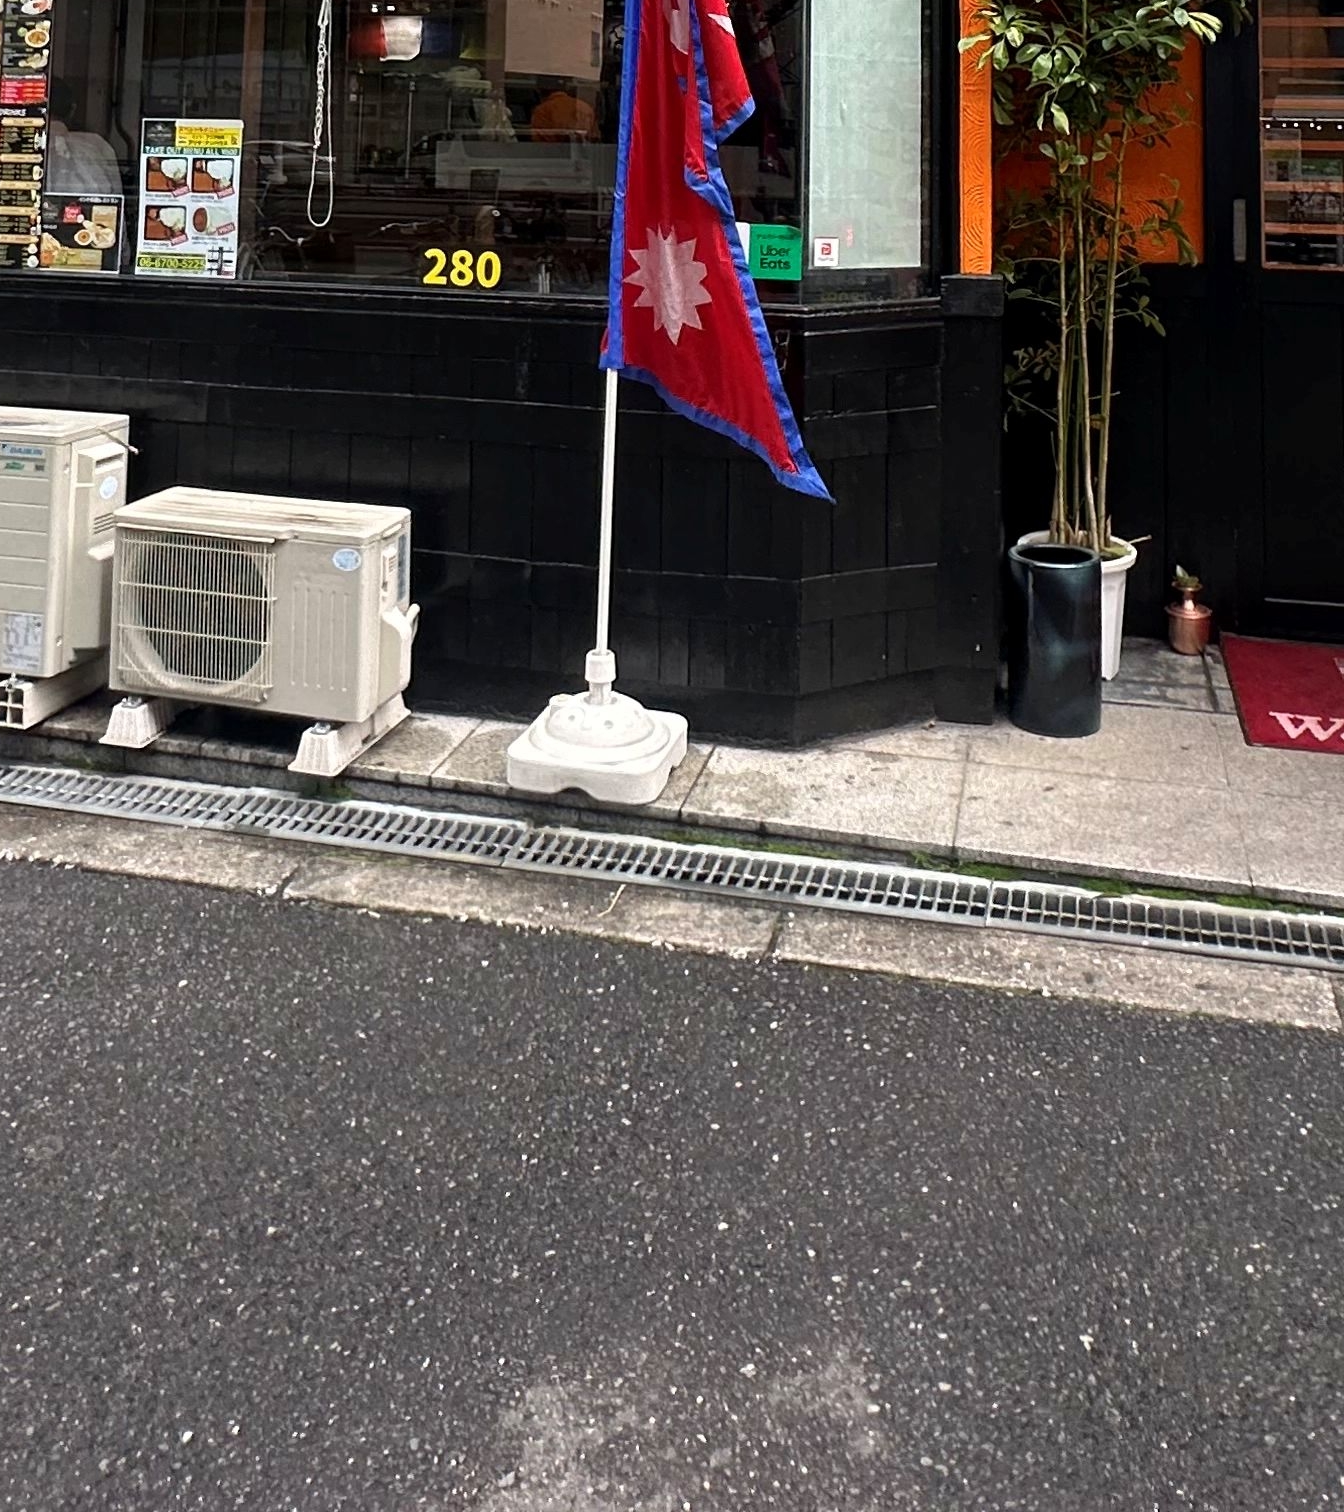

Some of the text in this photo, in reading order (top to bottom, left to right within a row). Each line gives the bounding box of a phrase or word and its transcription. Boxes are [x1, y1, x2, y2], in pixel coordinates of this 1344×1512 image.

[145, 146, 164, 155] TAKE
[166, 146, 181, 155] OUT
[206, 147, 219, 156] ALL
[760, 245, 790, 256] Uber
[423, 248, 502, 288] 280
[760, 258, 791, 269] Eats
